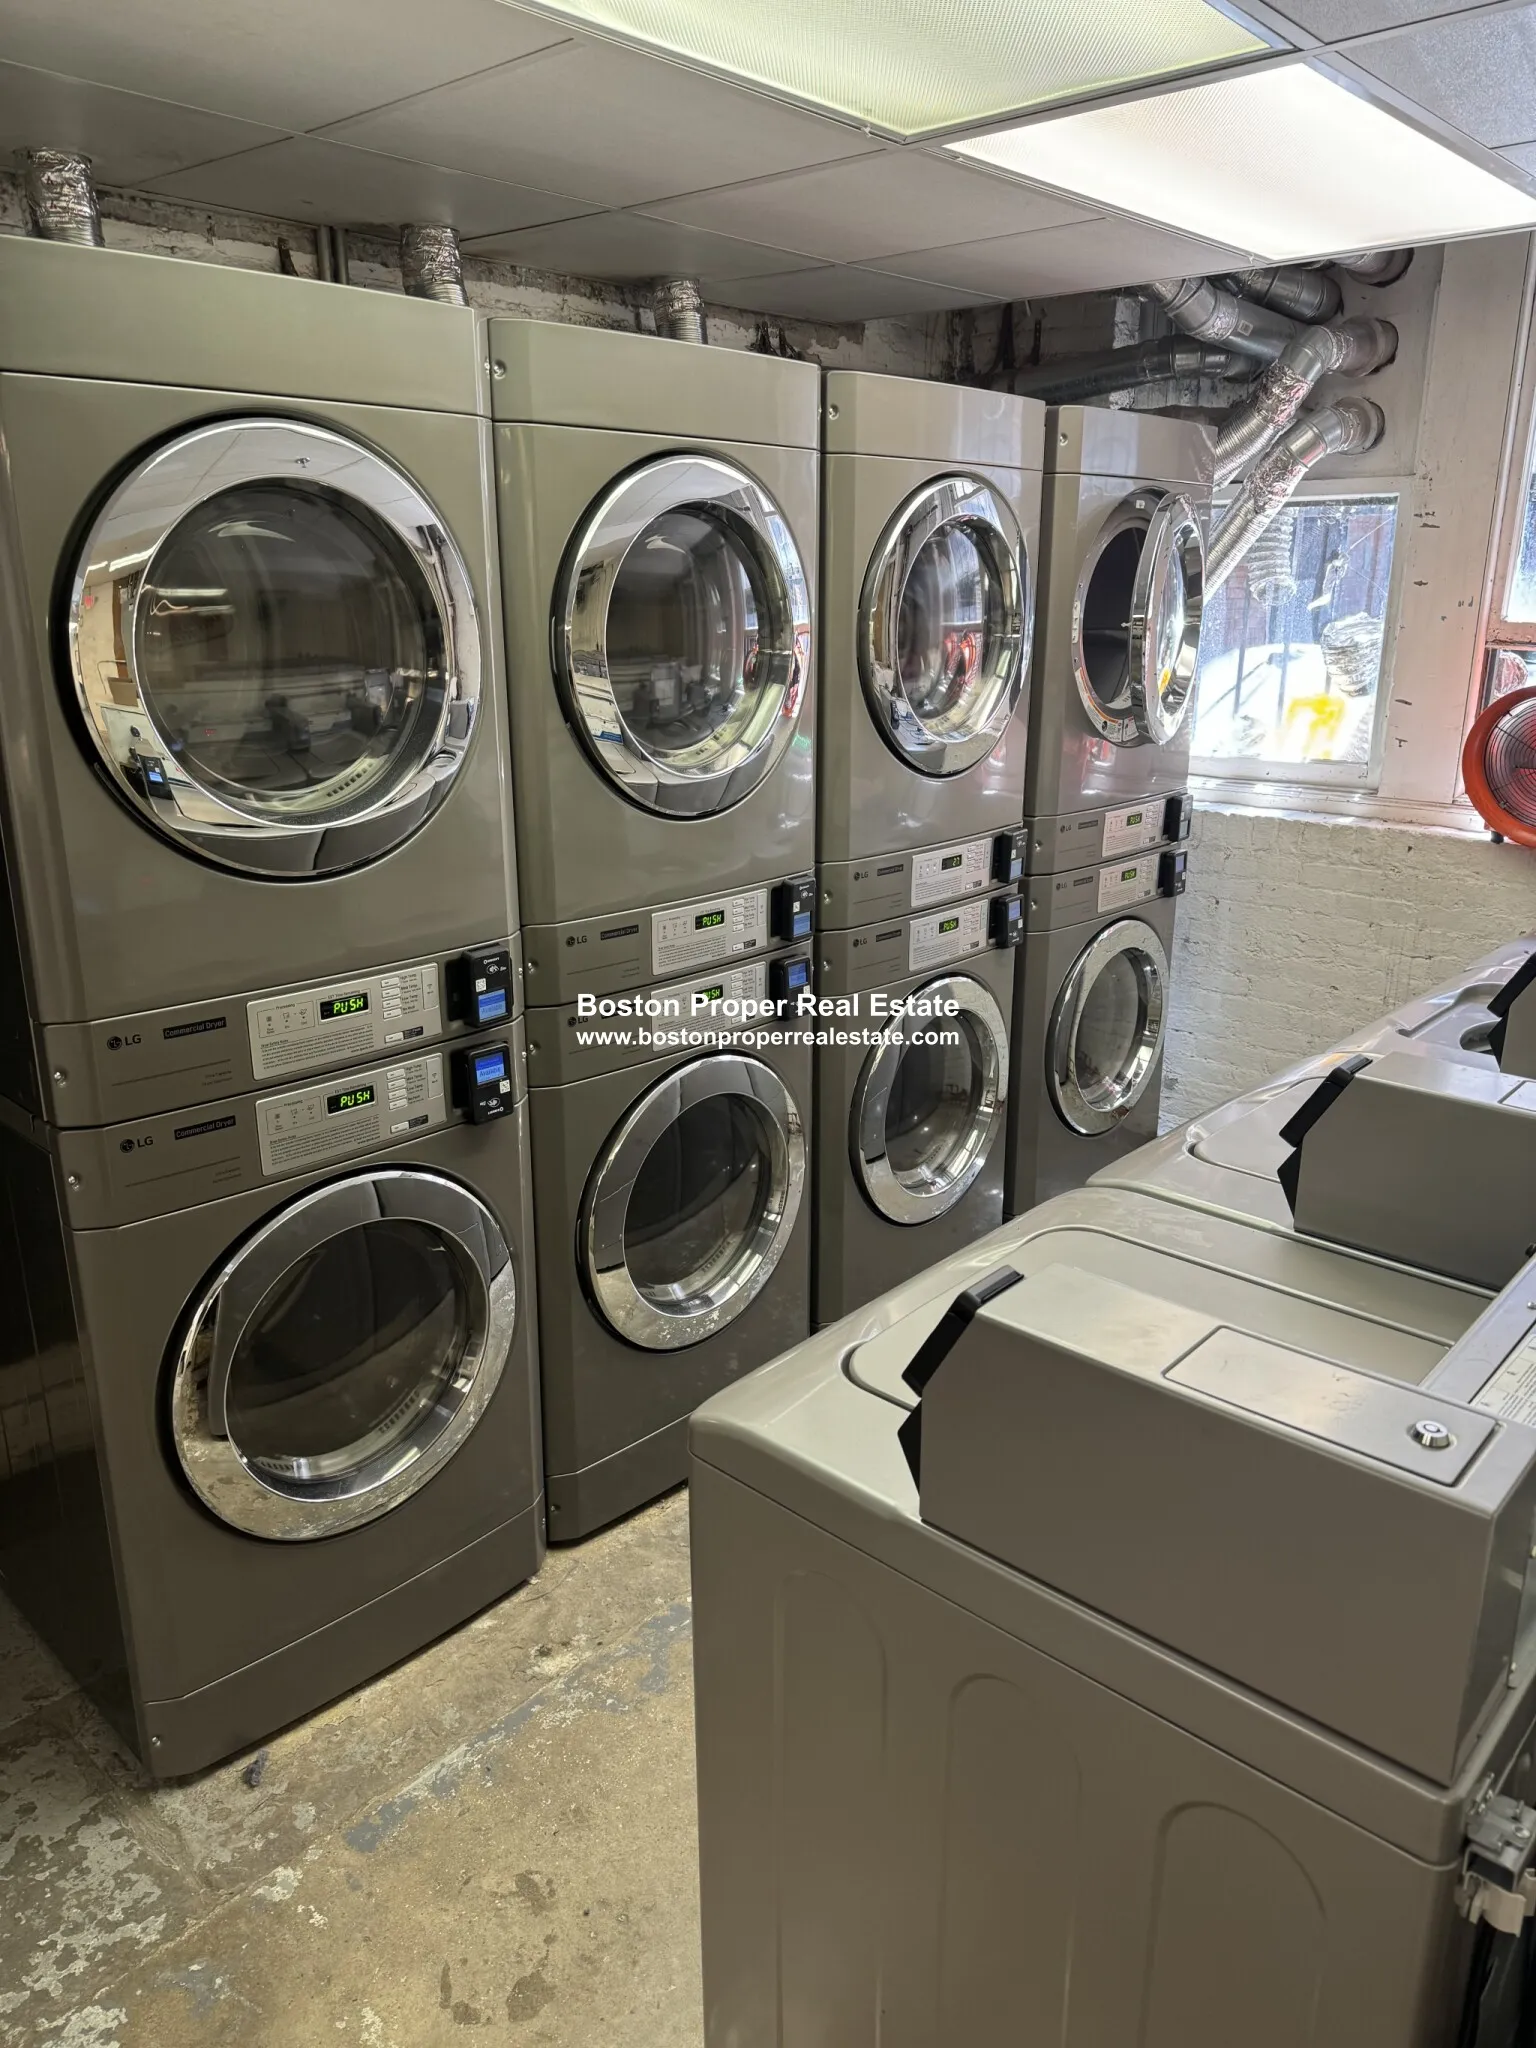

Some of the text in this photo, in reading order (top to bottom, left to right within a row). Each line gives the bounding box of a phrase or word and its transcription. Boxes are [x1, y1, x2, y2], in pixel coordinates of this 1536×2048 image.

[703, 914, 722, 926] PUSH
[576, 935, 588, 945] LG
[333, 997, 364, 1014] PUSH
[165, 1018, 225, 1038] Commercial Dryer
[125, 1034, 142, 1046] LG
[340, 1090, 370, 1108] PUSH
[176, 1118, 235, 1138] Commercial Dryer
[137, 1136, 154, 1148] LG
